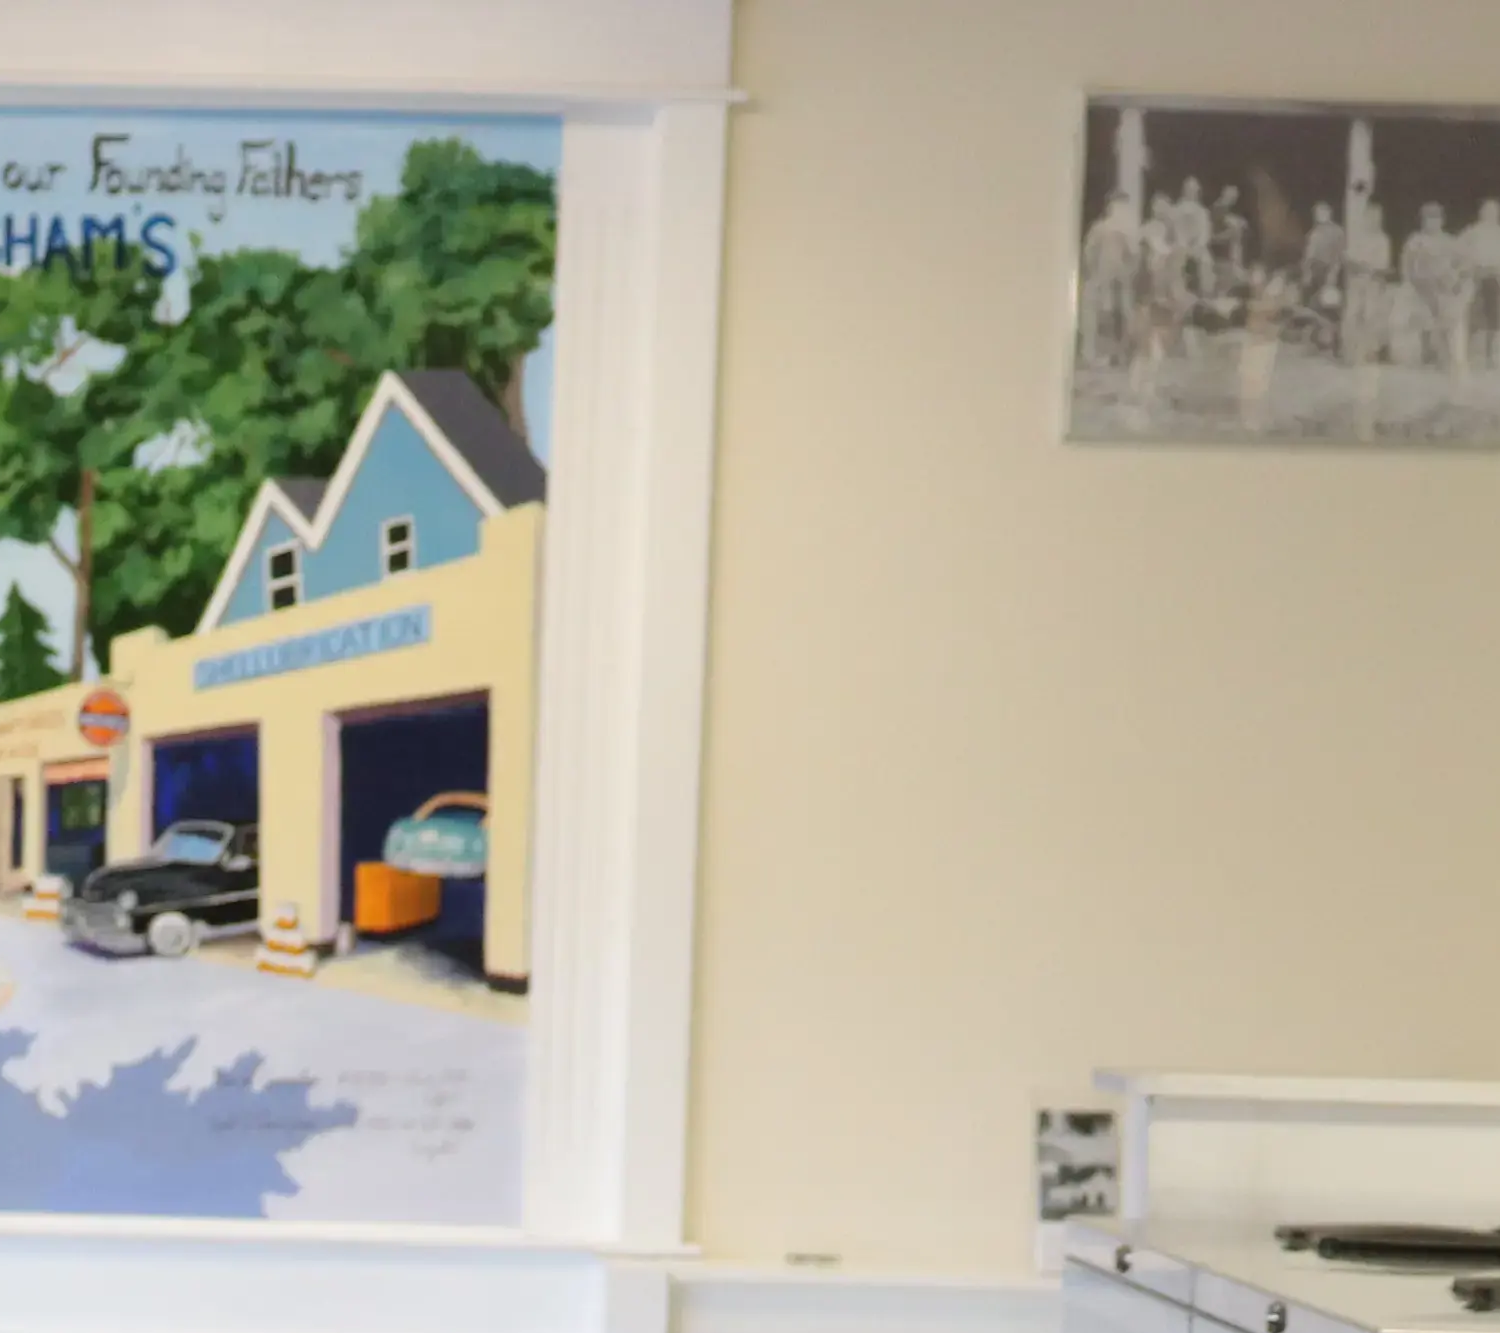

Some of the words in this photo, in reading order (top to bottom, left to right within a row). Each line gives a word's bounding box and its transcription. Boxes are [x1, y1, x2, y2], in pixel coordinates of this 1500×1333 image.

[3, 161, 66, 192] our
[89, 133, 226, 225] Founding
[236, 138, 361, 201] Fathers
